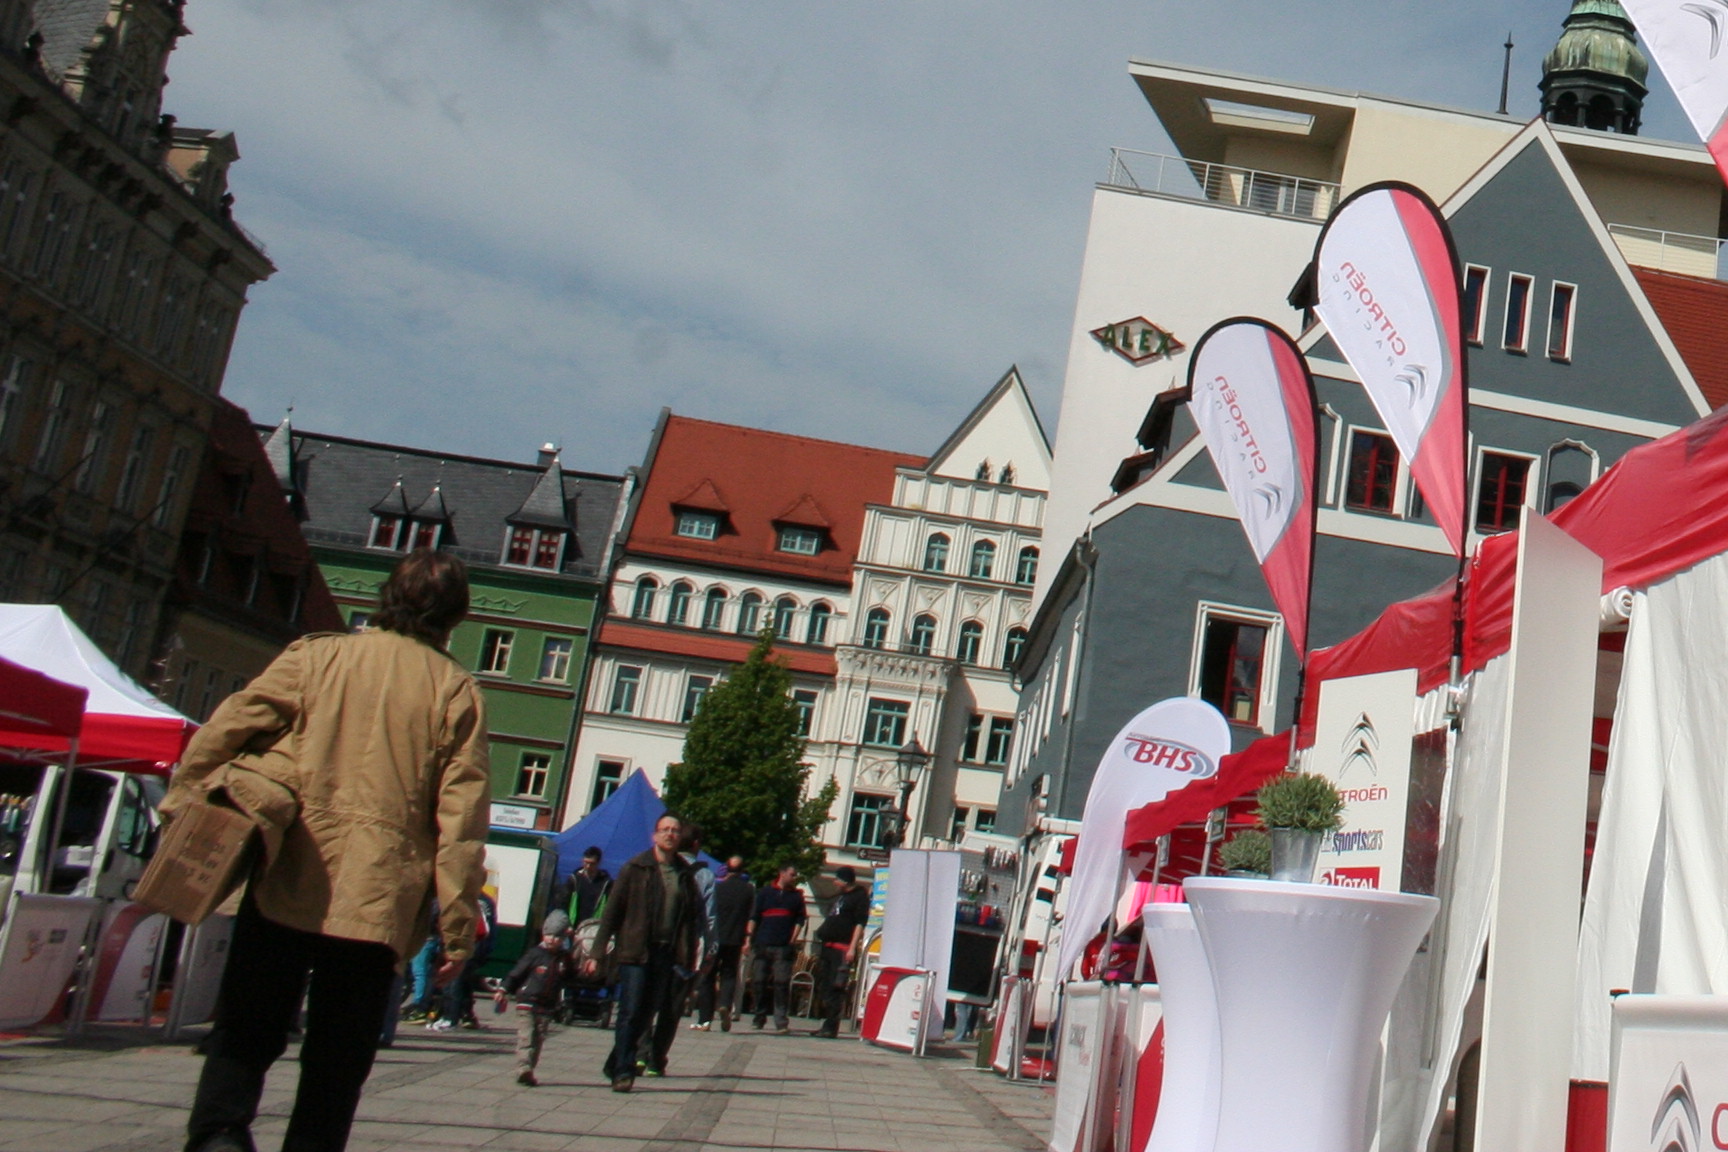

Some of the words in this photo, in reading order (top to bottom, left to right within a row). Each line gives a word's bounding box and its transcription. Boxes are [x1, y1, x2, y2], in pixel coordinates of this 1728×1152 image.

[1101, 323, 1174, 356] ALEX
[1126, 737, 1197, 772] BHS
[1338, 783, 1389, 803] TROËN
